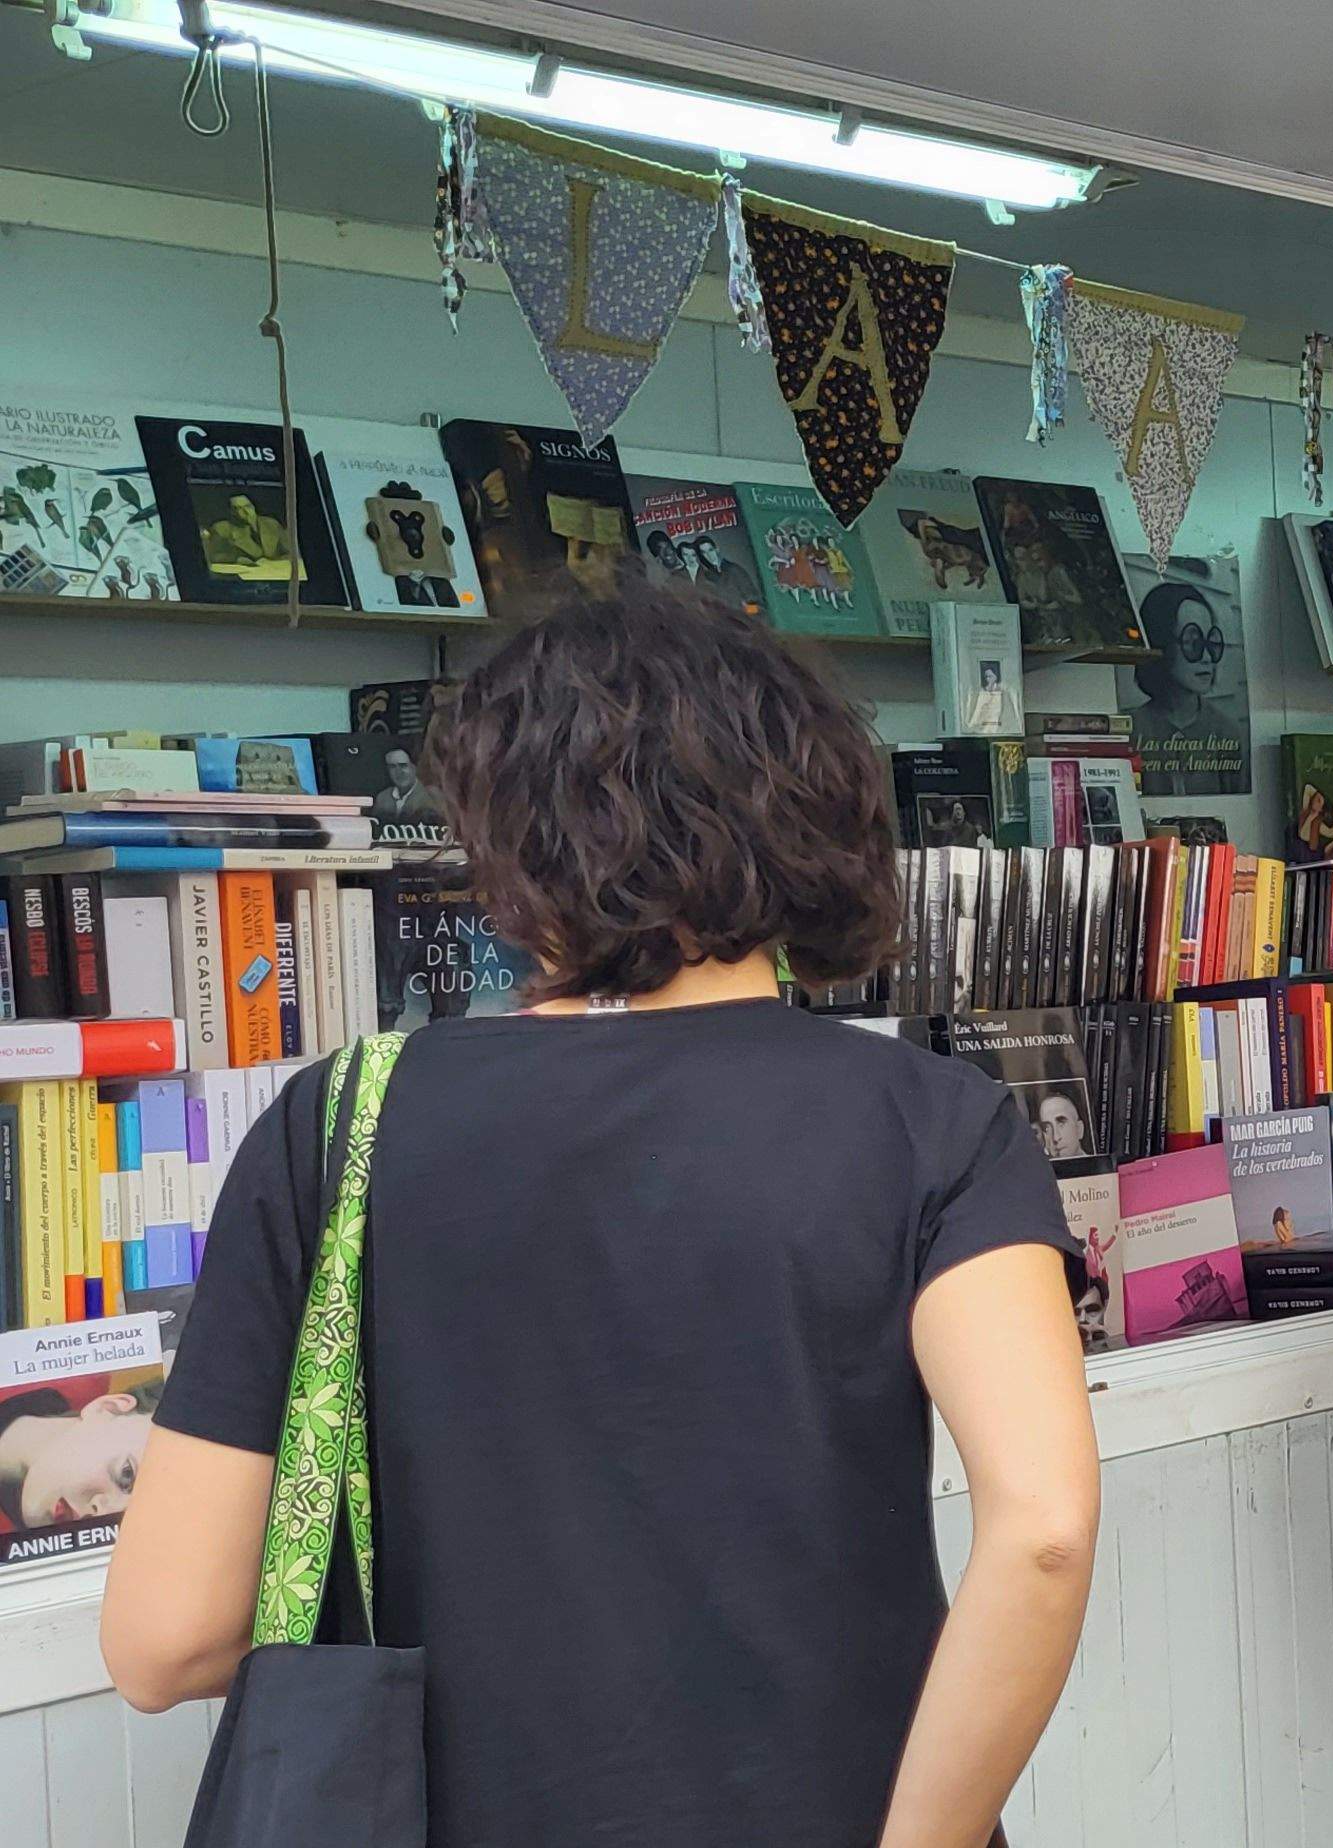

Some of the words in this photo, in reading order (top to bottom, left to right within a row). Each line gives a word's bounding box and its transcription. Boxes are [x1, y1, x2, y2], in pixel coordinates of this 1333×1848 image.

[0, 406, 31, 420] ARIO
[36, 409, 116, 427] ILUSTRADO
[5, 419, 23, 432] LA
[27, 422, 121, 440] NATURALEZA
[178, 426, 276, 462] Camus
[540, 441, 612, 462] SIGNOS
[752, 487, 832, 512] Escritor
[666, 521, 696, 539] BOB
[1137, 734, 1159, 751] Las
[1164, 733, 1203, 751] chicas
[1207, 733, 1240, 751] listas
[1164, 759, 1179, 771] en
[1185, 754, 1242, 772] Anónima
[304, 854, 348, 865] Literatura
[349, 853, 380, 864] infantil
[24, 888, 45, 928] NESBØ
[397, 894, 418, 905] EVA
[193, 884, 208, 948] JAVIER
[239, 886, 253, 950] BENAVENT
[252, 889, 266, 946] ELÍSABET
[399, 916, 424, 940] EL
[275, 922, 296, 1007] DIFERENTE
[427, 943, 459, 967] DE
[470, 943, 499, 966] LA
[409, 969, 514, 995] CIUDAD
[197, 955, 214, 1043] CASTILLO
[954, 1021, 972, 1035] Éric
[973, 1019, 1008, 1034] Vuillard
[1277, 997, 1285, 1033] PANERO
[16, 1046, 54, 1056] MUNDO
[956, 1039, 982, 1053] UNA
[983, 1037, 1022, 1051] SALIDA
[1024, 1033, 1075, 1048] HONROSA
[1278, 1035, 1288, 1065] MARÍA
[37, 1088, 47, 1123] espacio
[67, 1086, 78, 1152] perfecciones
[1231, 1123, 1254, 1141] MAR
[1256, 1118, 1291, 1138] GARCÍA
[1292, 1115, 1314, 1135] PUIG
[37, 1125, 47, 1140] del
[38, 1142, 48, 1172] través
[1232, 1144, 1248, 1160] La
[1251, 1139, 1292, 1157] historia
[68, 1153, 78, 1172] Las
[1233, 1161, 1248, 1177] de
[1249, 1158, 1265, 1175] los
[1266, 1152, 1324, 1173] vertebrados
[40, 1180, 50, 1214] cuerpo
[1069, 1187, 1110, 1204] Molino
[39, 1215, 49, 1228] del
[1124, 1217, 1149, 1228] Pedro
[1126, 1229, 1135, 1239] El
[1137, 1225, 1153, 1236] año
[1154, 1221, 1166, 1232] del
[1167, 1216, 1198, 1229] desierto
[39, 1232, 51, 1288] movimiento
[41, 1288, 51, 1301] El
[35, 1335, 83, 1353] Annie
[87, 1326, 144, 1345] Ernaux
[14, 1357, 38, 1376] La
[42, 1351, 89, 1371] mujer
[94, 1343, 145, 1362] helada
[8, 1532, 74, 1560] ANNIE
[78, 1523, 121, 1548] ERN
